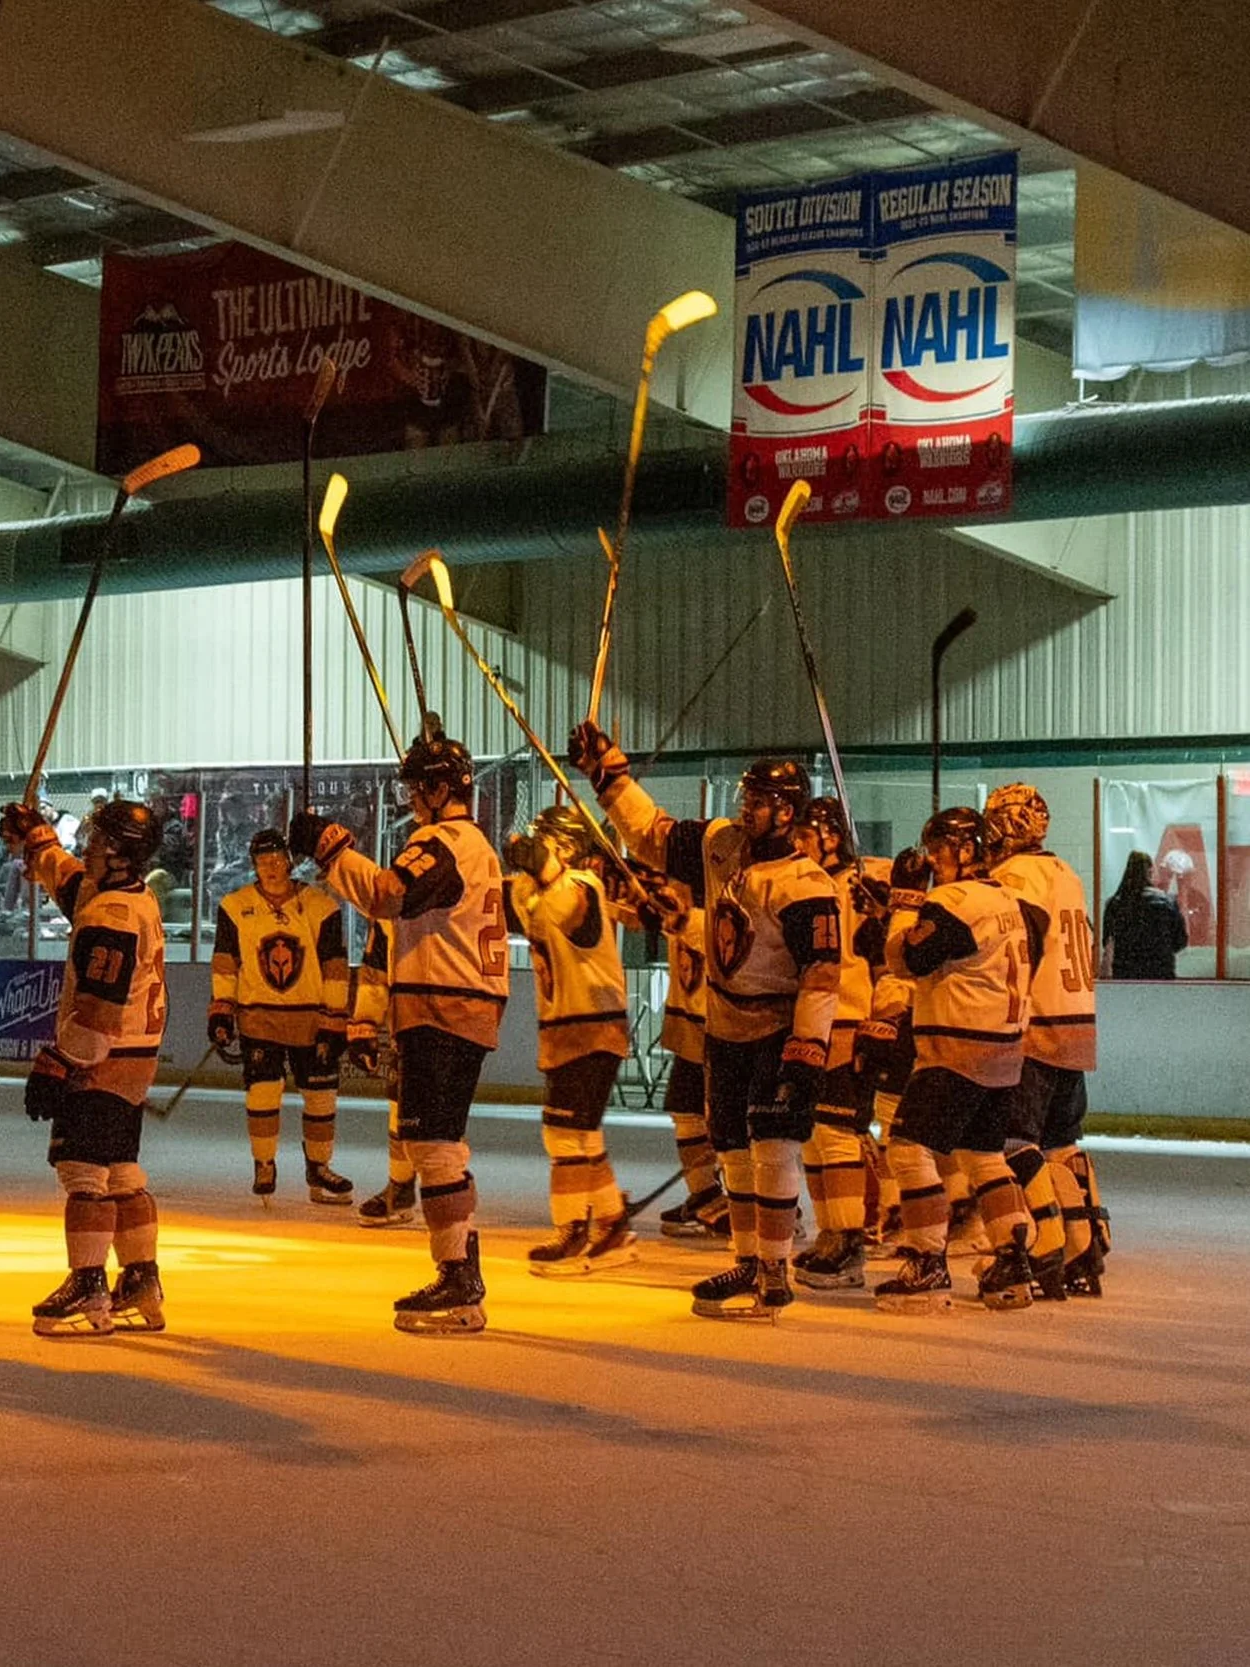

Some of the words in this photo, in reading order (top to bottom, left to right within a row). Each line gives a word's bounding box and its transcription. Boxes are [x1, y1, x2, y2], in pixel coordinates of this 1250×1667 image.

[746, 198, 797, 236] SOUTH
[799, 189, 862, 227] DIVISION
[879, 180, 950, 222] REGULAR
[952, 173, 1012, 208] SEASON
[212, 286, 256, 341] THE
[881, 286, 1010, 369] NAHL
[212, 340, 291, 399] Sports
[295, 325, 372, 394] Lodge
[742, 302, 865, 383] NAHL
[775, 446, 829, 465] OKLAHOMA
[916, 434, 972, 454] OKLAHOMA
[393, 844, 437, 878] 22
[1060, 909, 1094, 993] 30
